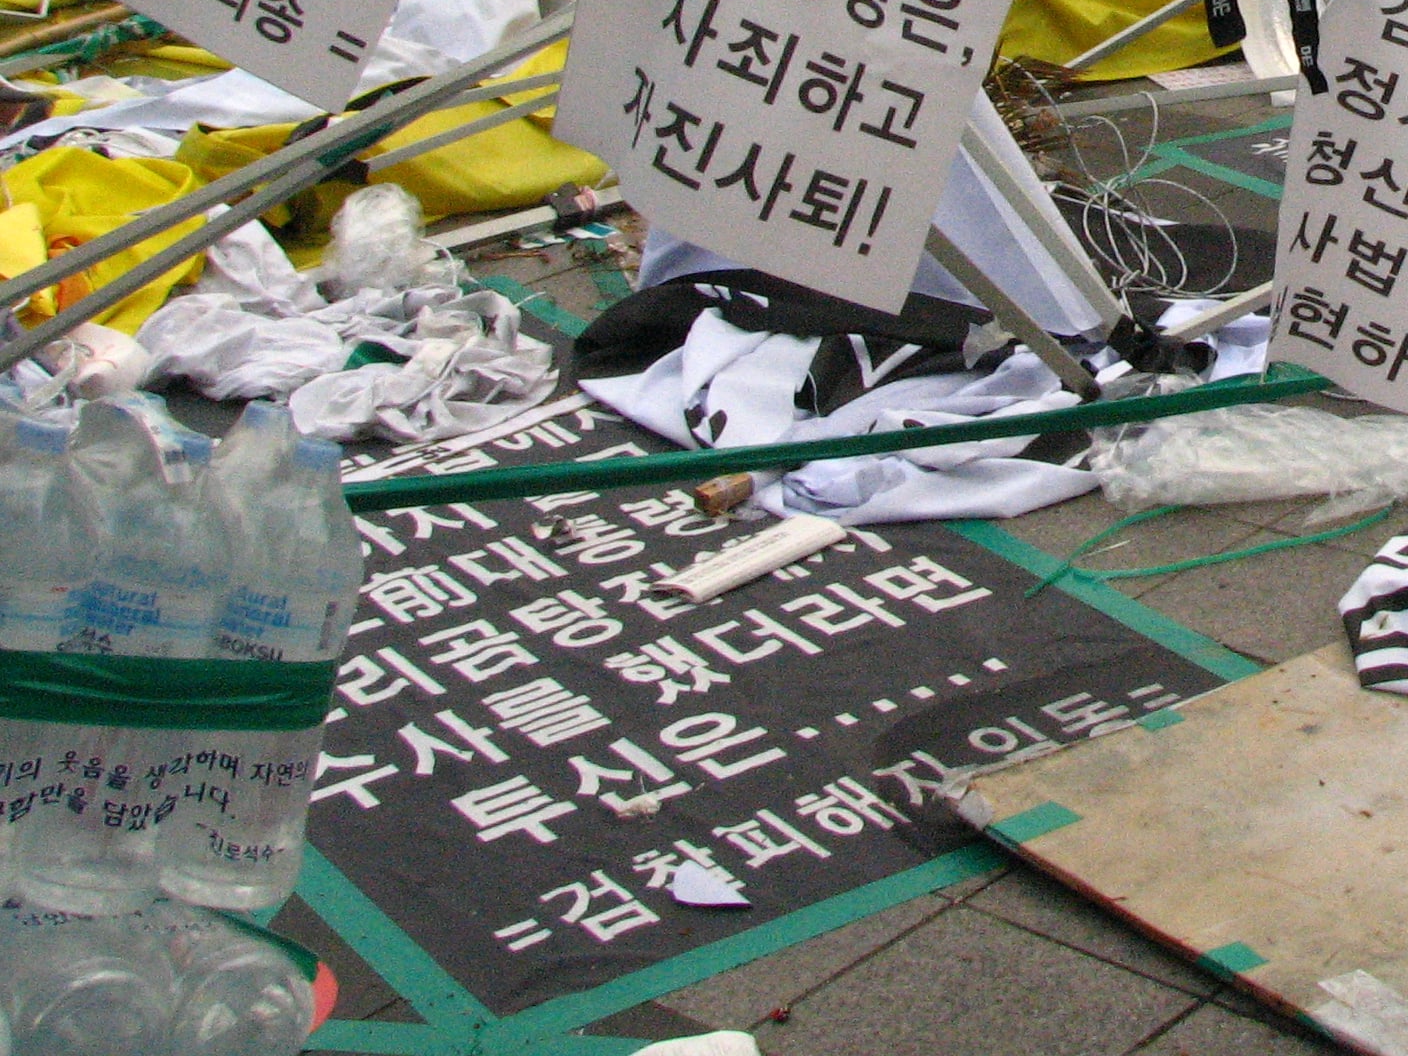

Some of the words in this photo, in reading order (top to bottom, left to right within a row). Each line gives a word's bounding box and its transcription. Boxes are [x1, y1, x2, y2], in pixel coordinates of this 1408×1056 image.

[622, 66, 892, 257] 자진사퇴!
[605, 555, 993, 705] 했더라면
[145, 749, 240, 790] 생각하며
